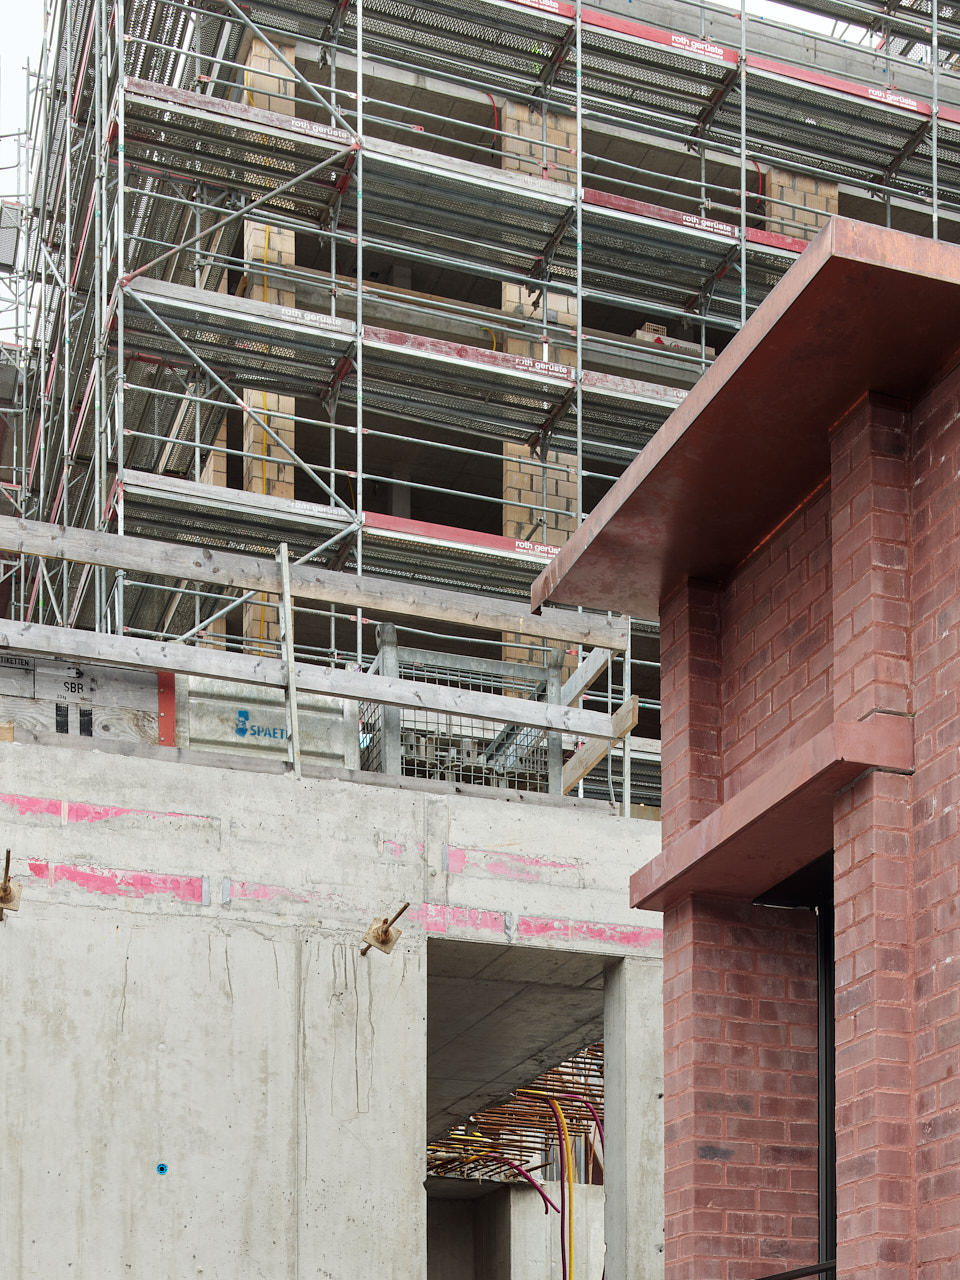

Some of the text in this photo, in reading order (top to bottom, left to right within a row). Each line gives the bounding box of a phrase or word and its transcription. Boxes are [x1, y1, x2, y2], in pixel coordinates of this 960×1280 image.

[671, 35, 689, 46] roth
[691, 40, 723, 55] gerüste
[868, 89, 885, 98] roth
[291, 120, 310, 129] roth
[312, 125, 347, 138] gerüste
[682, 215, 699, 224] roth
[701, 219, 732, 232] gerüste
[515, 358, 533, 367] roth
[535, 361, 568, 374] gerüste
[515, 540, 533, 550] roth
[534, 544, 561, 555] gerüst
